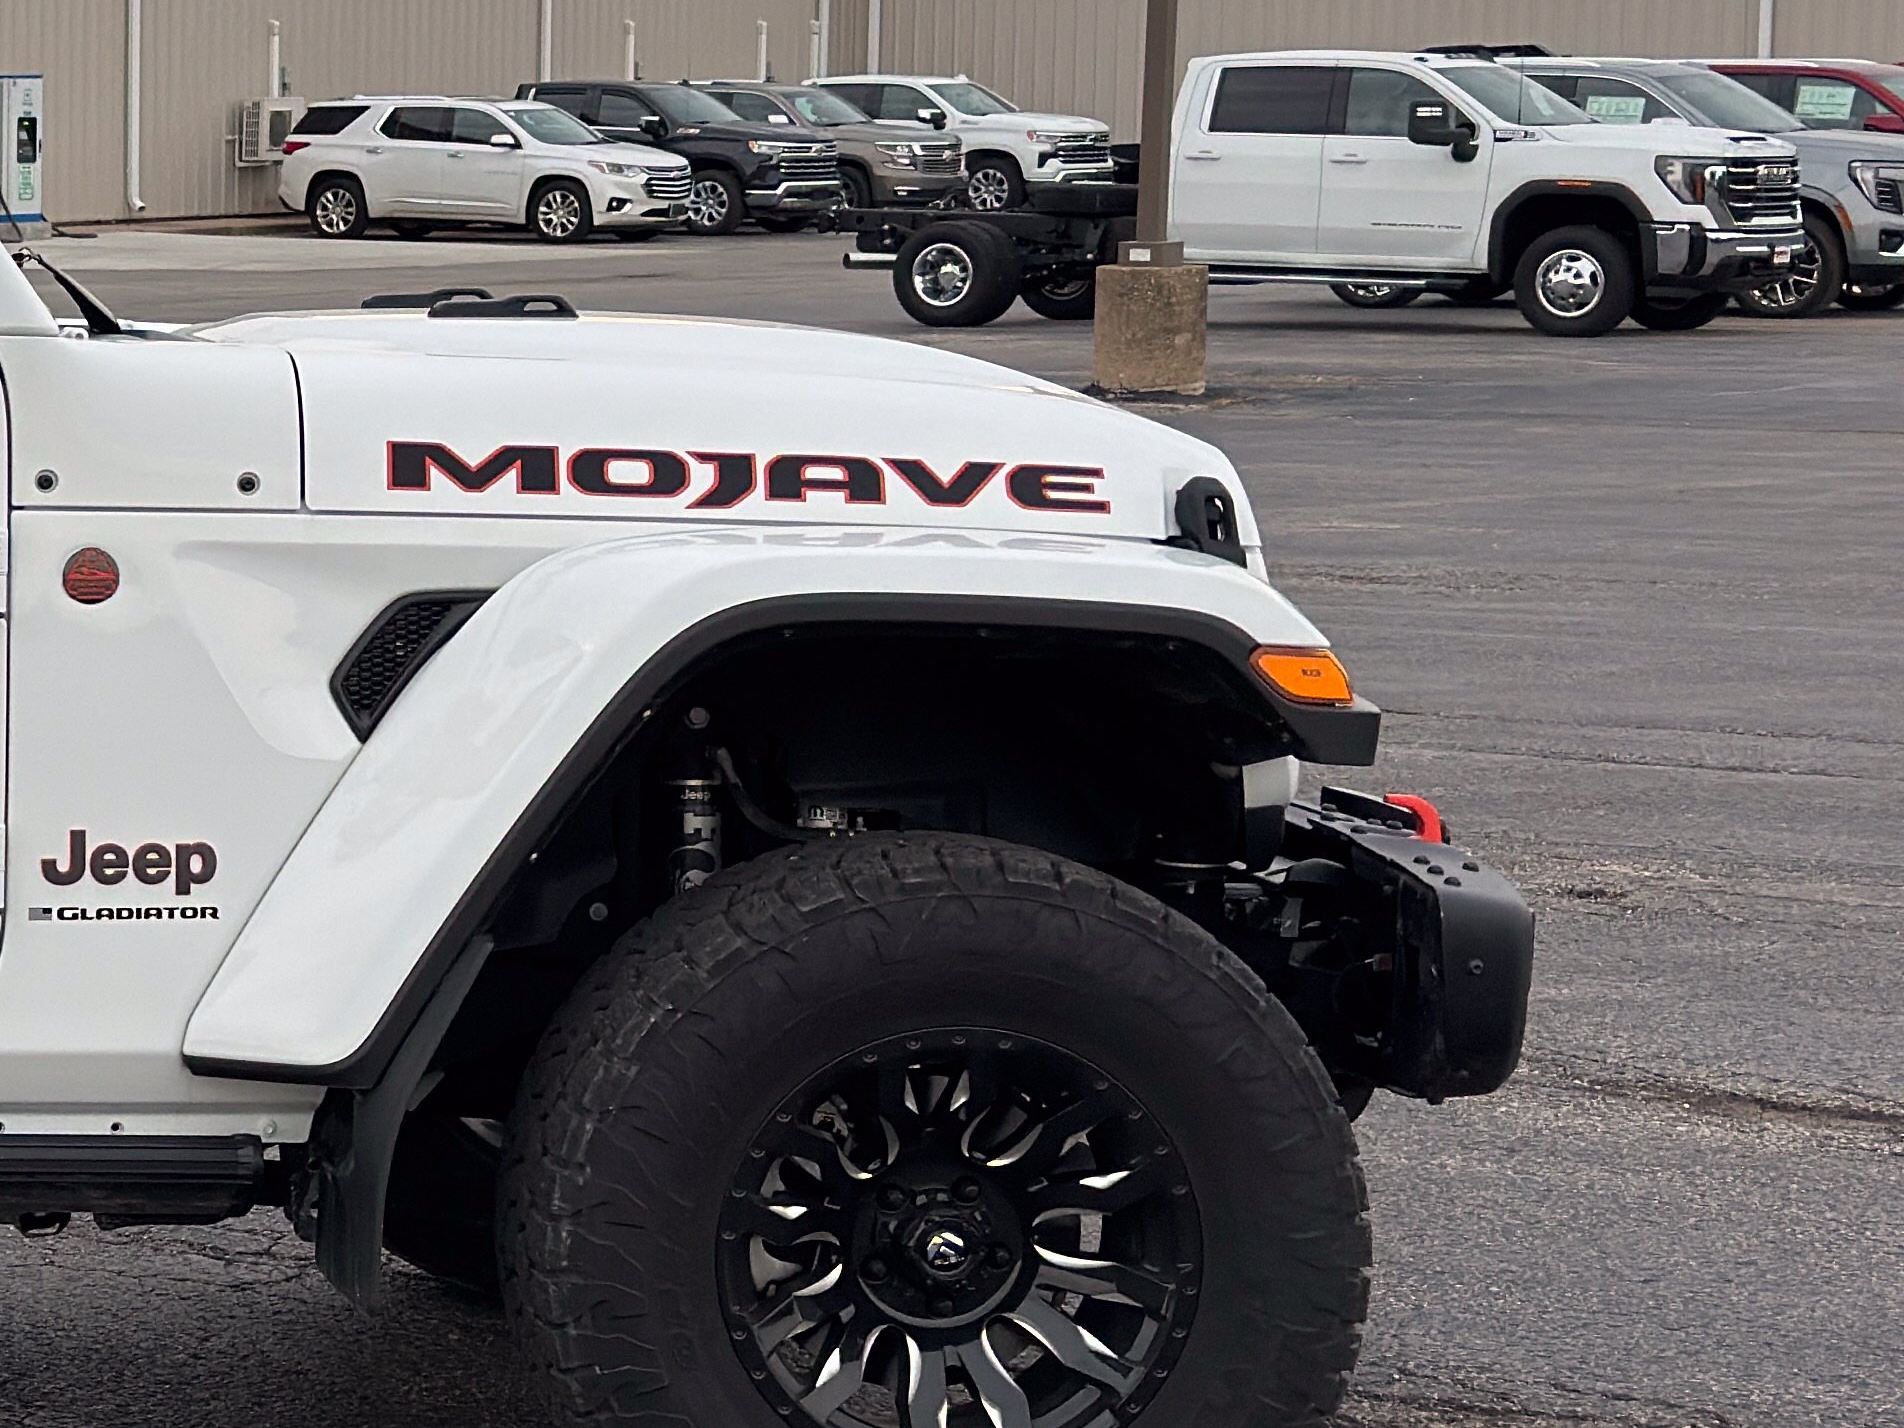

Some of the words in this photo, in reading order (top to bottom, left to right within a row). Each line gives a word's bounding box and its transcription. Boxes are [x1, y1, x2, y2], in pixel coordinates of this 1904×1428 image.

[386, 439, 1111, 514] MOJAVE
[680, 788, 711, 802] Jeep
[40, 829, 218, 896] Jeep
[57, 906, 219, 921] GLADIATOR
